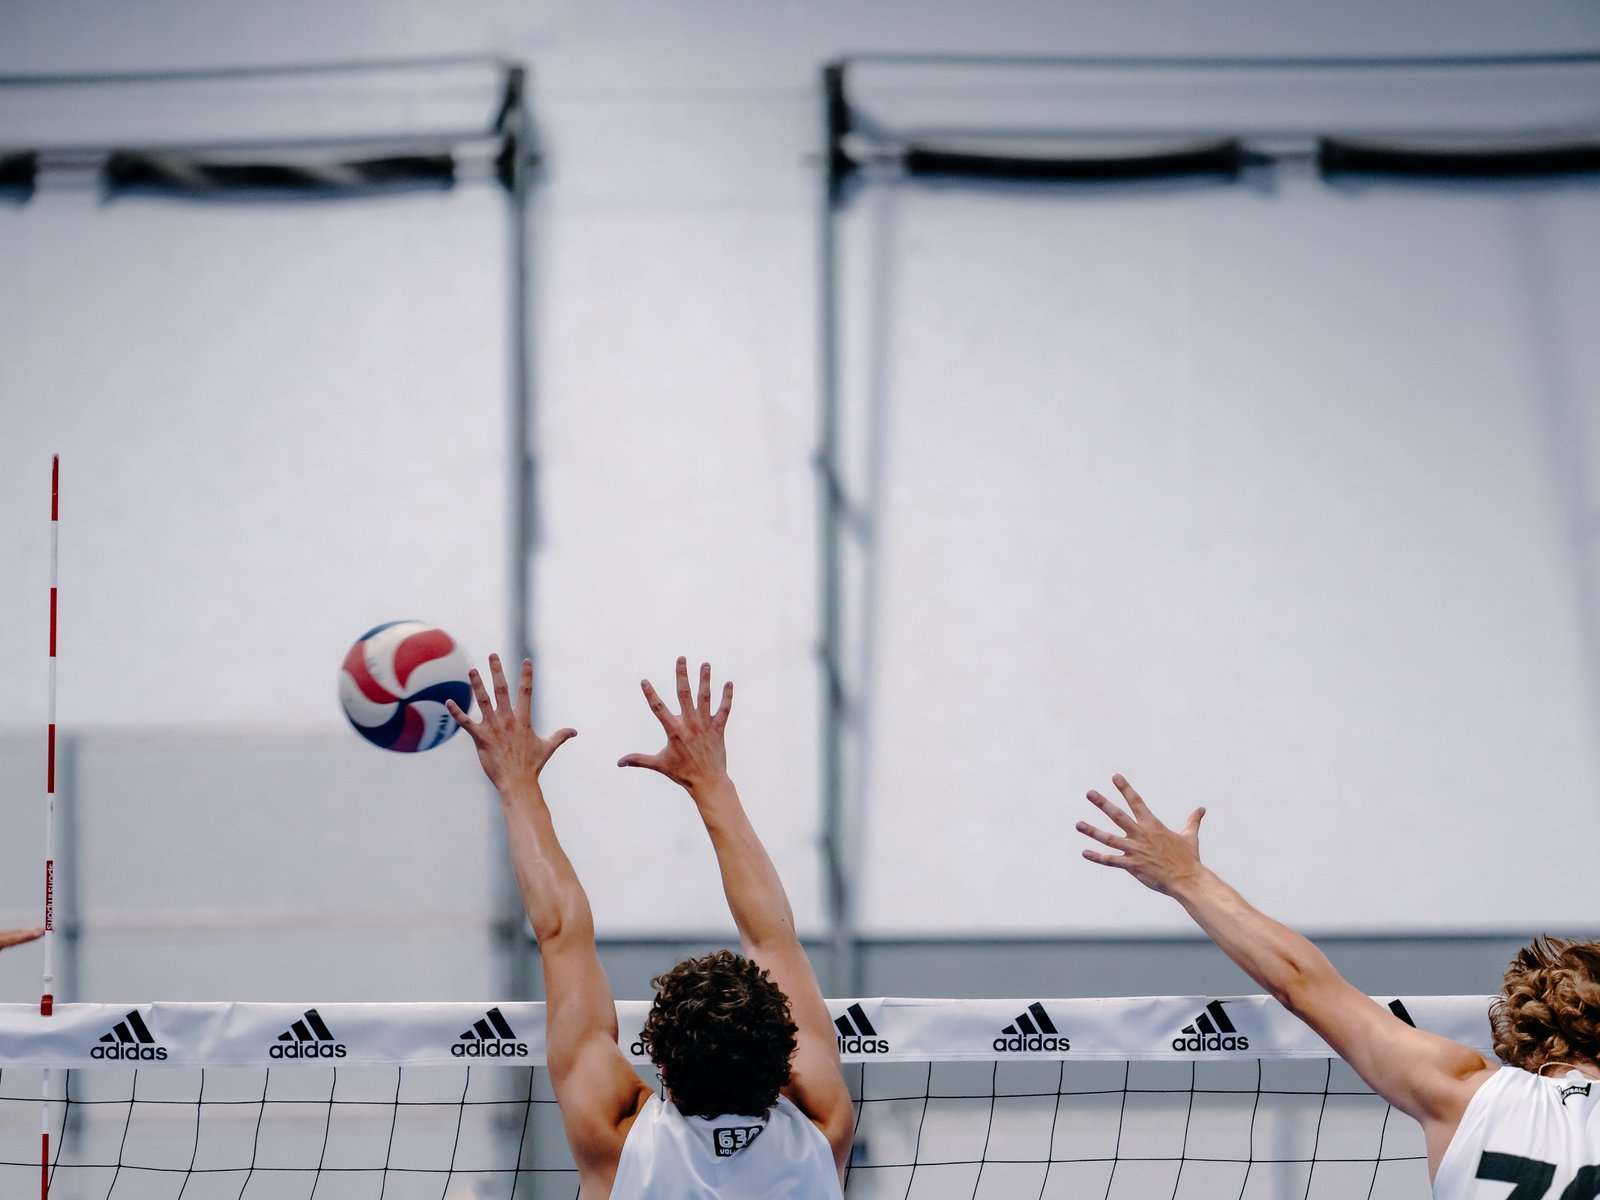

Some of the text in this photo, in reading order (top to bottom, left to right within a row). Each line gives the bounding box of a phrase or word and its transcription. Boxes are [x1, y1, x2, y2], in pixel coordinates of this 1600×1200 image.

[90, 1042, 168, 1060] adidas
[269, 1040, 347, 1059] adidas
[451, 1039, 528, 1057] adidas
[838, 1036, 889, 1054] idas
[993, 1034, 1070, 1052] adidas
[1172, 1033, 1249, 1051] adidas
